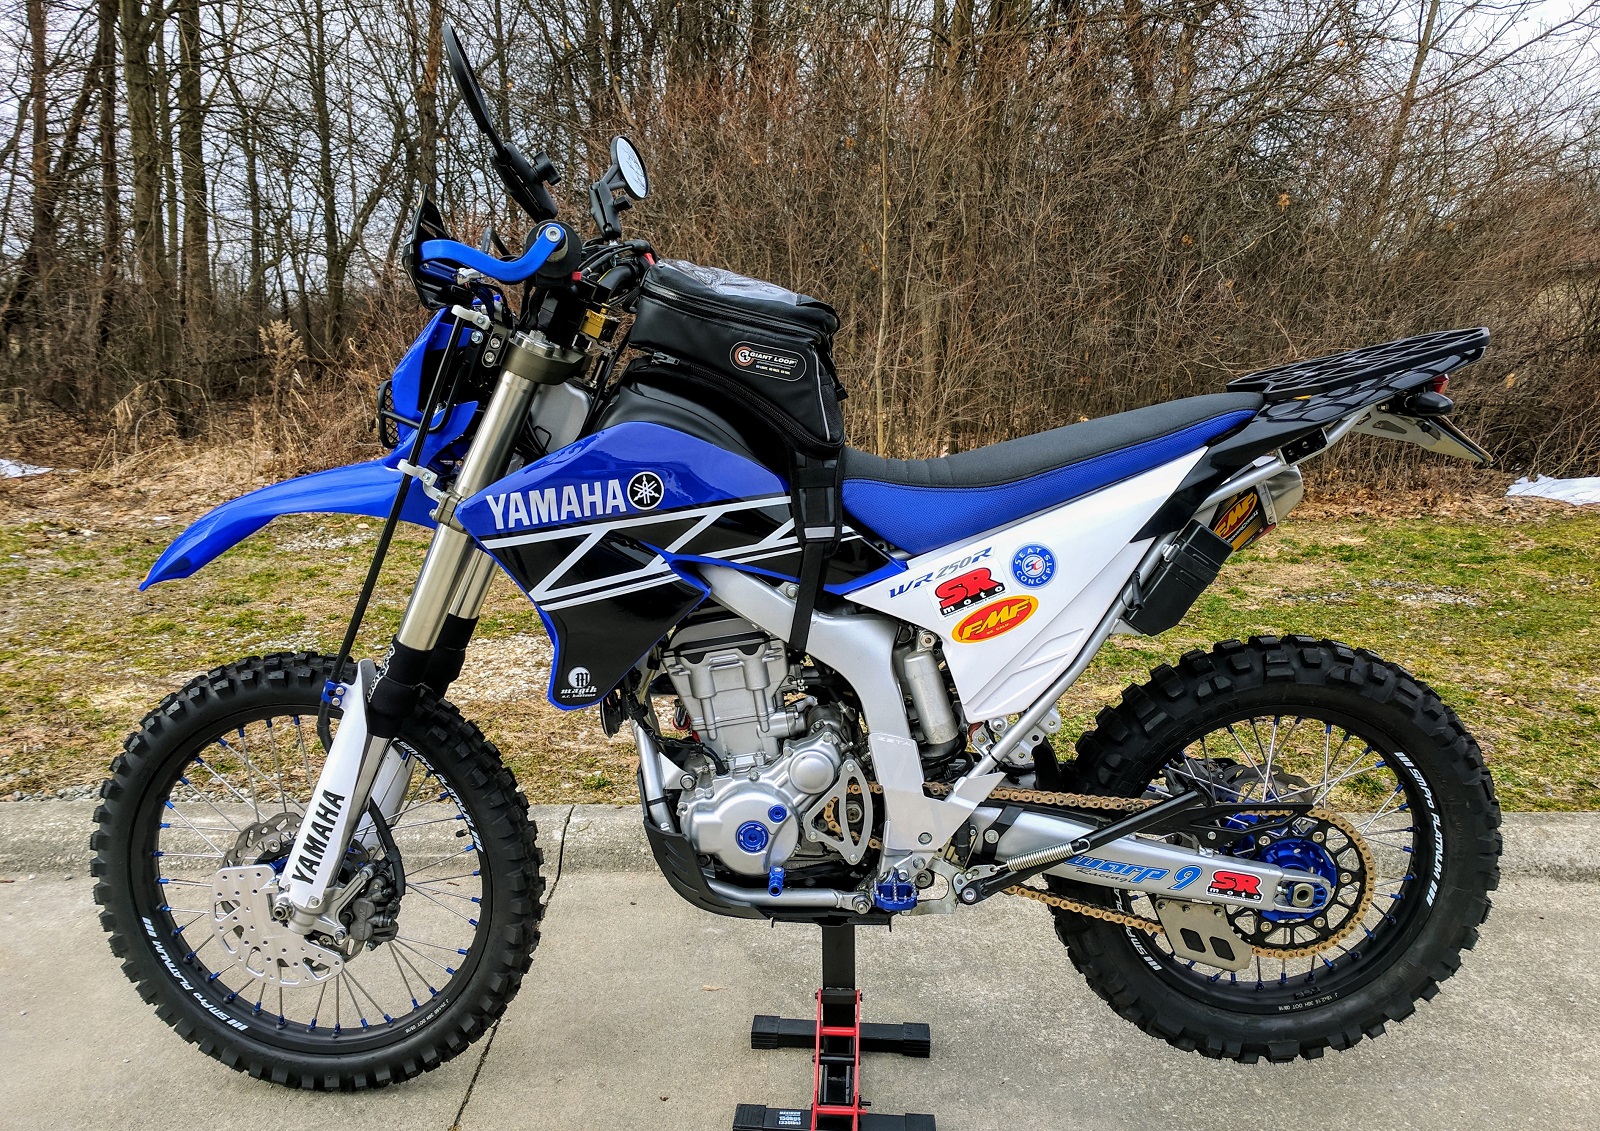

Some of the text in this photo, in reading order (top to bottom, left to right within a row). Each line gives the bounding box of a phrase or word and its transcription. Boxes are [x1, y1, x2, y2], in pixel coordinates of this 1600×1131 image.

[750, 352, 796, 365] GIANT LOOP
[486, 479, 627, 530] YAMAHA
[1214, 491, 1254, 537] FMF
[1015, 547, 1042, 567] SEAT
[1016, 554, 1053, 585] CONCEPTS
[935, 567, 1001, 609] SR
[943, 585, 1005, 615] moto
[961, 598, 1031, 641] FMF
[560, 685, 598, 695] magik
[435, 773, 475, 828] PLATINUM
[291, 789, 346, 885] YAMAHA
[1430, 812, 1443, 880] PLATINUM
[1168, 864, 1203, 891] 9
[1210, 887, 1260, 900] moto
[1211, 870, 1261, 895] SR
[152, 940, 194, 991] PLATINUM
